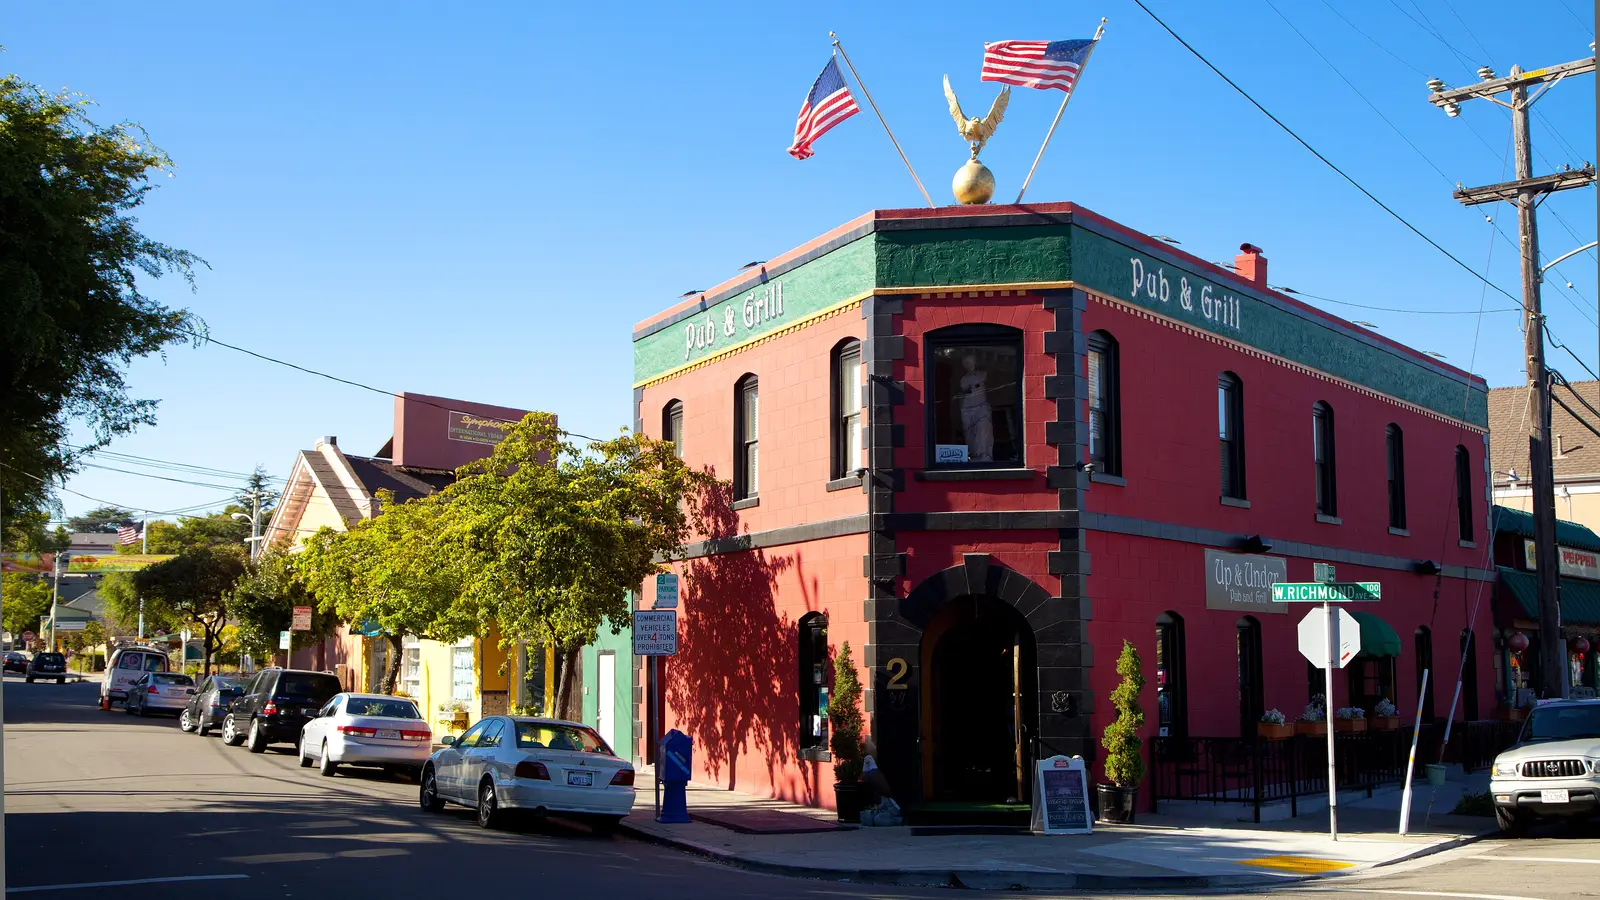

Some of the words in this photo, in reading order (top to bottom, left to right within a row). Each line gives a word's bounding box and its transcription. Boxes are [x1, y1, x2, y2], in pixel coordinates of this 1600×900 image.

[1130, 257, 1170, 303] Pub
[1180, 276, 1193, 312] &
[1201, 285, 1241, 330] Grill
[684, 313, 716, 361] Pub
[723, 304, 736, 338] &
[743, 279, 785, 330] Grill
[1562, 551, 1597, 569] PEPPER
[1214, 558, 1232, 592] Up
[1234, 563, 1243, 587] &
[1244, 561, 1279, 592] Under
[1367, 584, 1379, 592] 100
[1229, 588, 1242, 604] Pub
[1242, 591, 1254, 603] and
[1255, 590, 1268, 604] Grill
[1355, 592, 1368, 600] AVE
[636, 614, 674, 622] COMMERCIAL
[640, 624, 671, 632] VEHICLES
[636, 633, 651, 641] OVER
[651, 632, 658, 643] 4
[660, 633, 675, 641] TONS
[637, 643, 674, 651] PROHIBITED
[886, 657, 908, 690] 2
